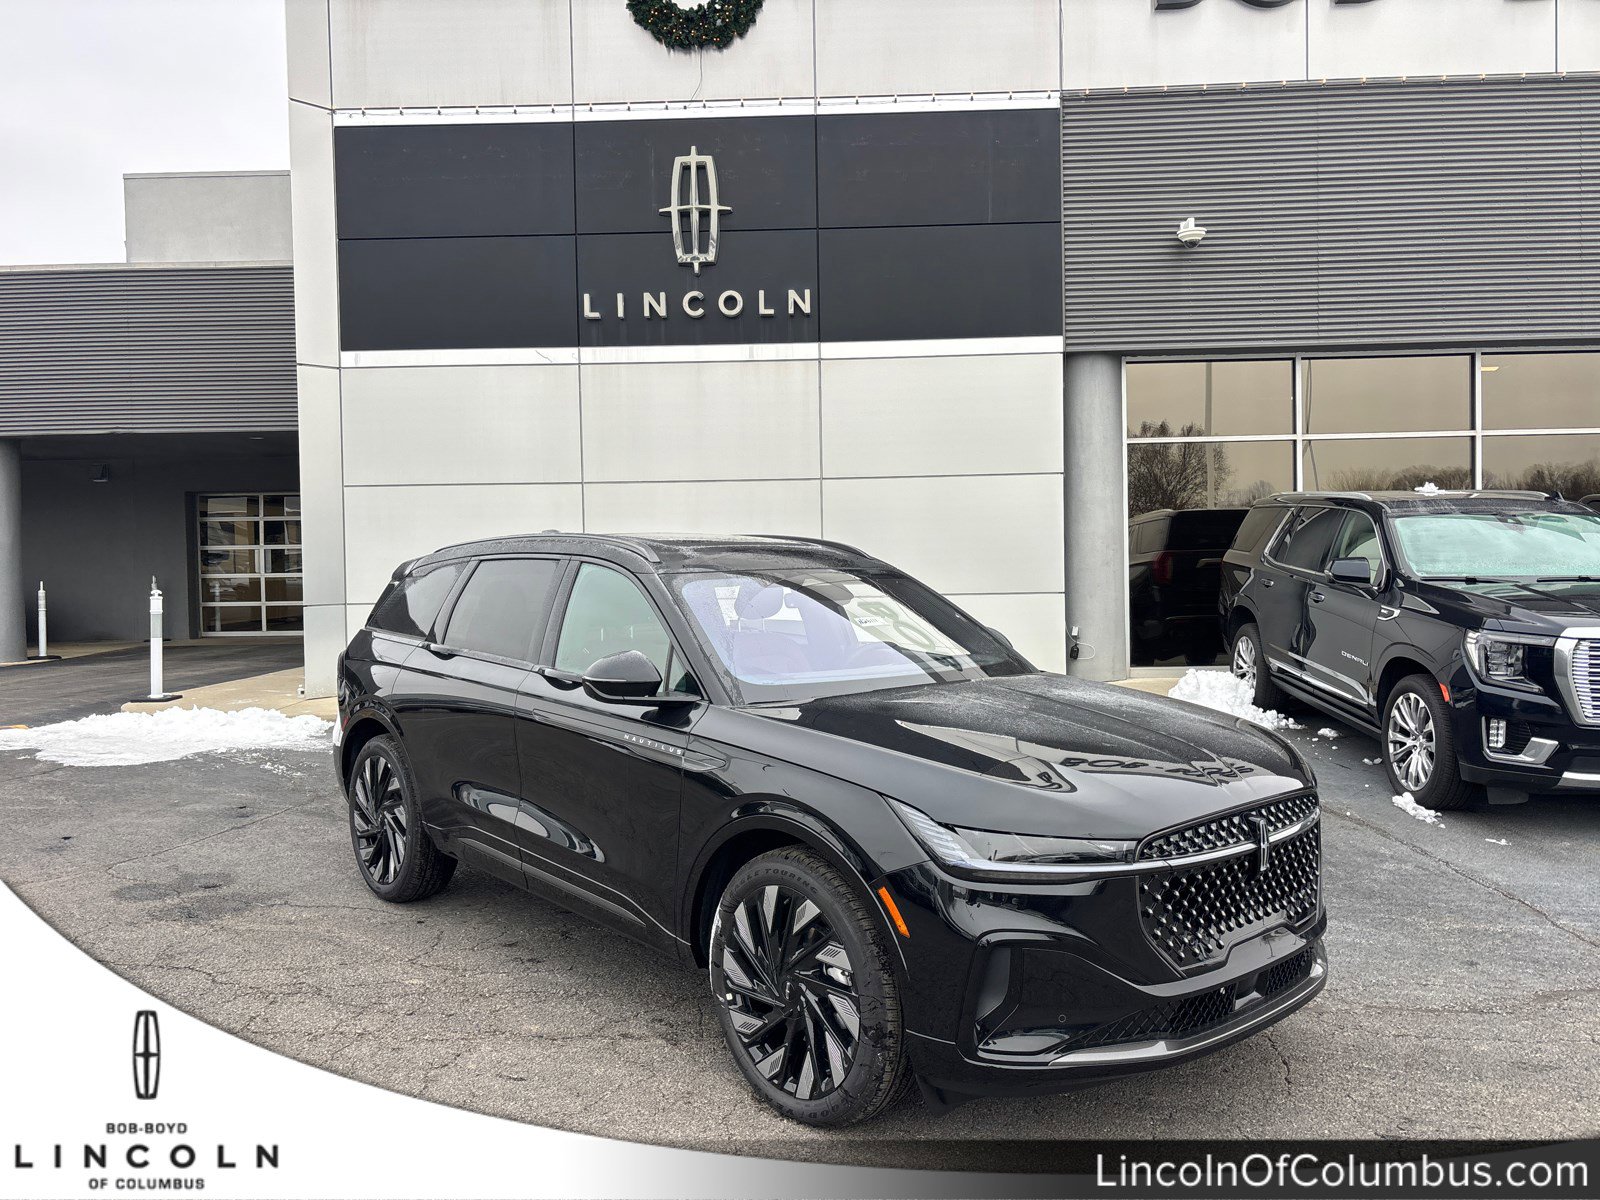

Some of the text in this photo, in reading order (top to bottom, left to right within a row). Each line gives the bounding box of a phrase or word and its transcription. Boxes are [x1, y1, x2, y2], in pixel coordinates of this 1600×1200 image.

[583, 288, 811, 320] LINCOLN
[1341, 650, 1369, 667] DENALI
[623, 733, 682, 755] NAUTILUS
